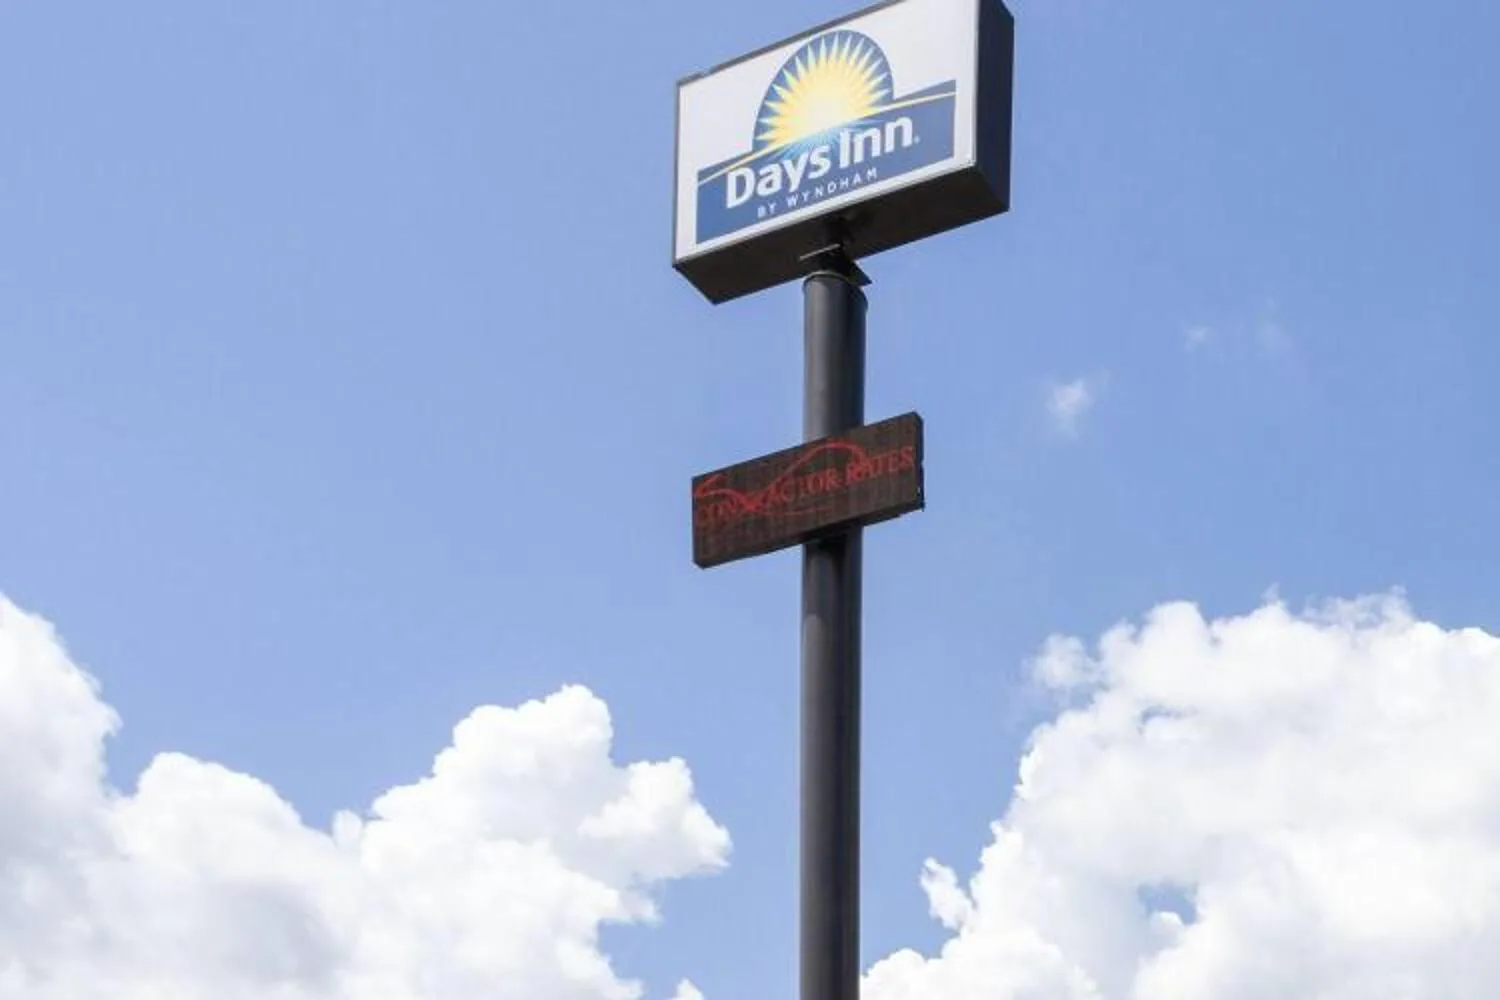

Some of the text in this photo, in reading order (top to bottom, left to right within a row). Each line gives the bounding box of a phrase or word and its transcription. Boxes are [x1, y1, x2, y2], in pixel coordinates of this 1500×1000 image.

[726, 116, 913, 209] Days Inn
[757, 167, 877, 218] BY WYNDHAM
